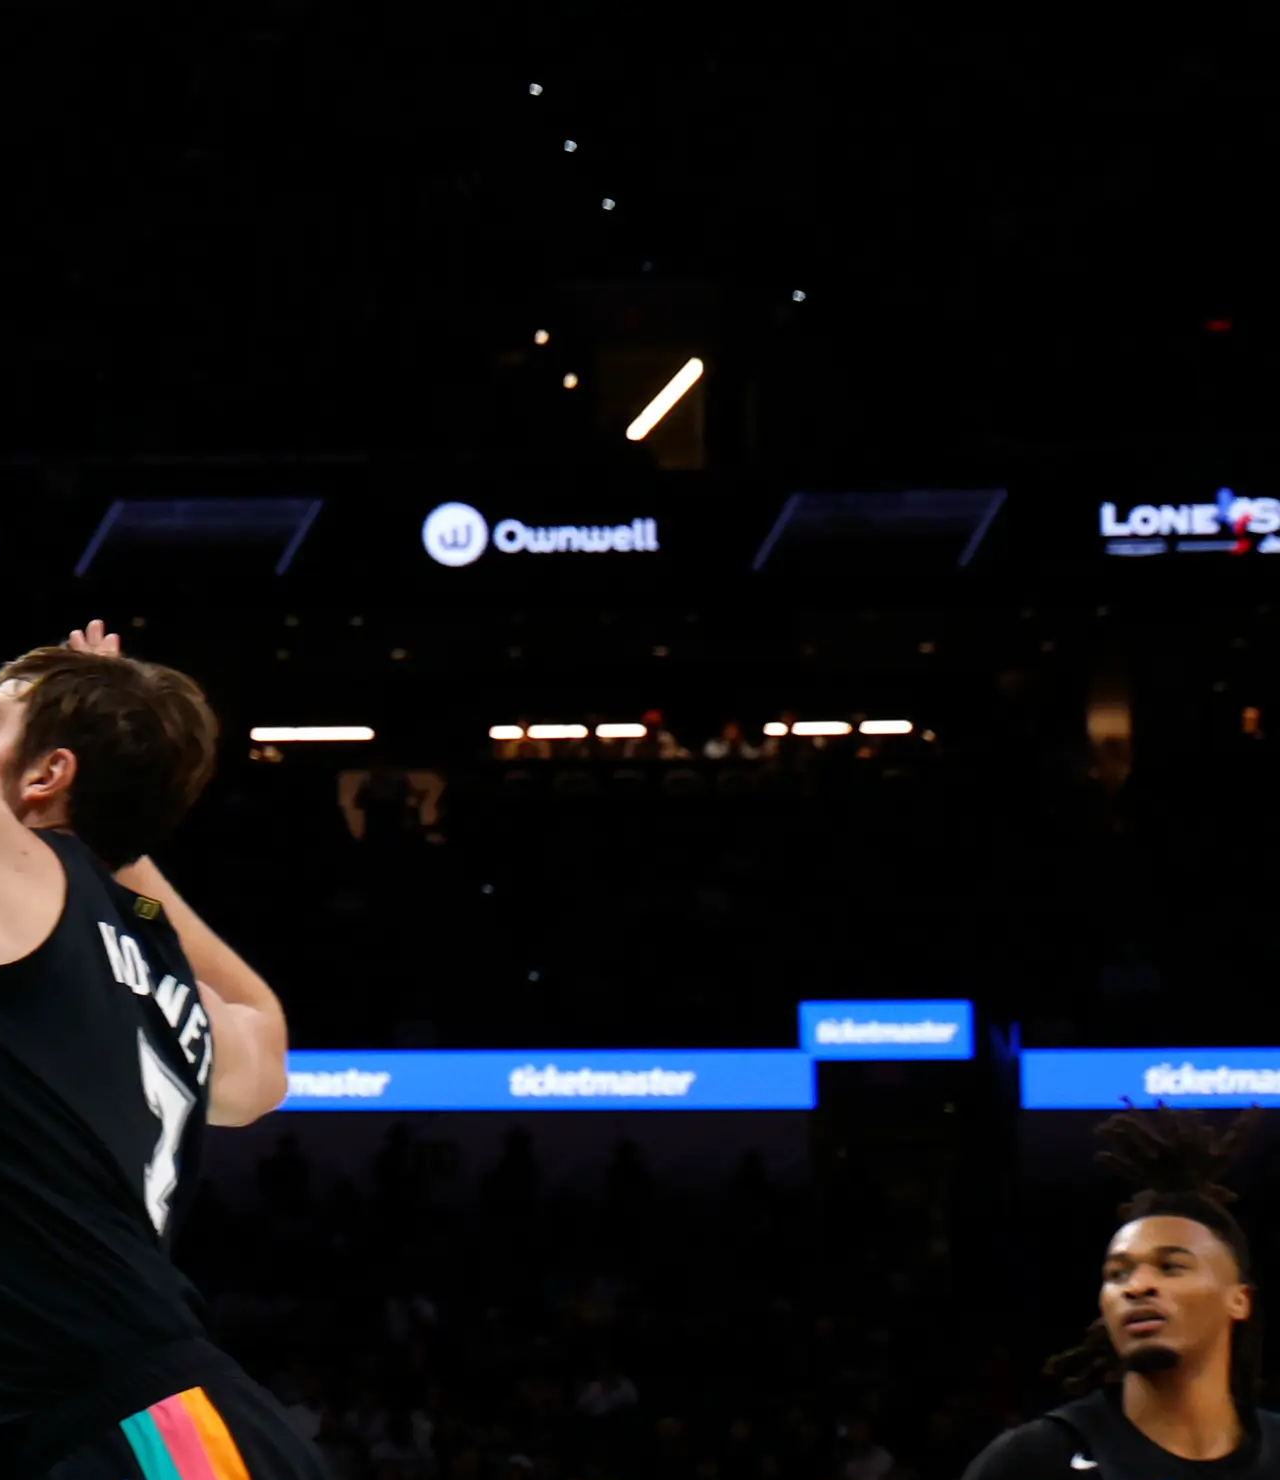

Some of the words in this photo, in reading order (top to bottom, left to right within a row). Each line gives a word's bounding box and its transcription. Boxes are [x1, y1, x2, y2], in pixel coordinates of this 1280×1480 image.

[493, 517, 659, 553] Ownwell
[1099, 500, 1221, 537] LONE
[508, 1064, 696, 1097] ticketmaster
